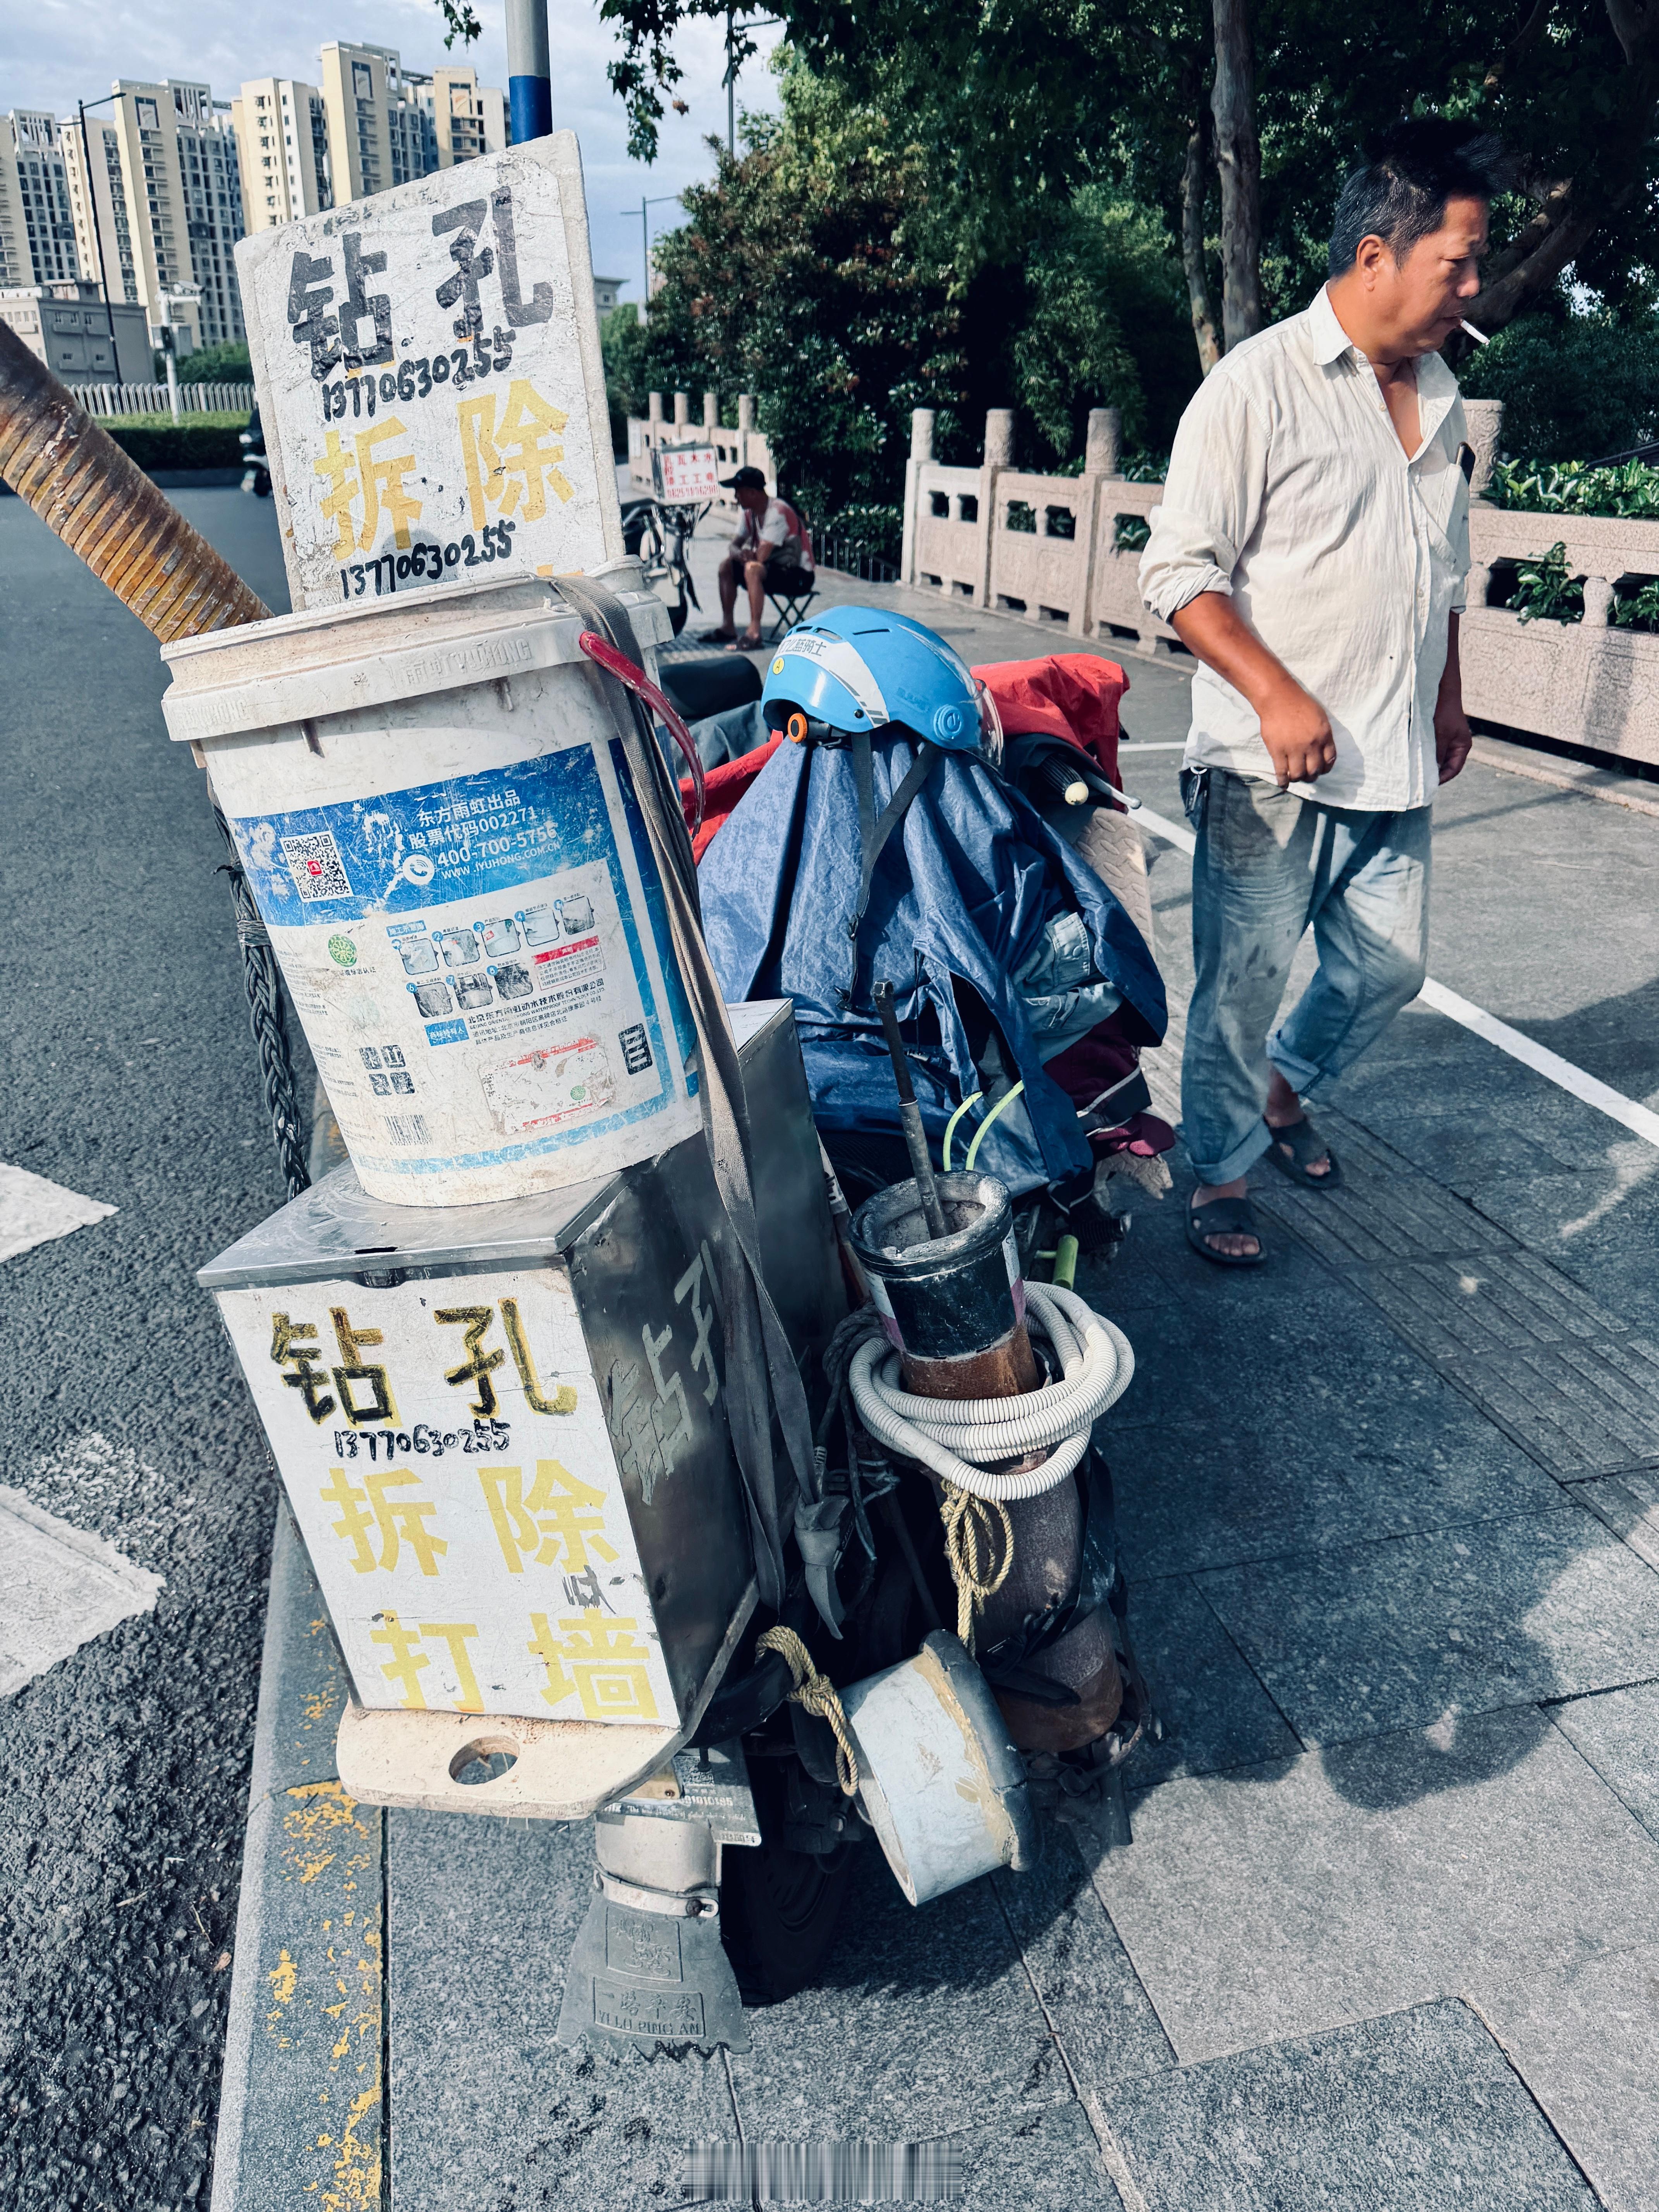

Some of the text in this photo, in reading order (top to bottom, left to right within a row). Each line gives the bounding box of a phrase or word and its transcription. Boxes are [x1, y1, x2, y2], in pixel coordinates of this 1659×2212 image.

[287, 186, 553, 382] 钻孔
[322, 326, 517, 422] 13770630255
[314, 378, 575, 562] 拆除
[341, 519, 516, 599] 13770630255
[409, 805, 538, 849] 股票代码002271
[417, 789, 521, 828] 东方雨虹出品
[468, 978, 604, 1024] 北京东方雨虹防水技术股份有限公司
[531, 1002, 561, 1014] WATERPROOF
[270, 1298, 578, 1427] 钻孔
[334, 1420, 512, 1461] 13770630255
[320, 1459, 620, 1576] 拆除
[370, 1607, 660, 1719] 打墙
[615, 2015, 632, 2030] LU
